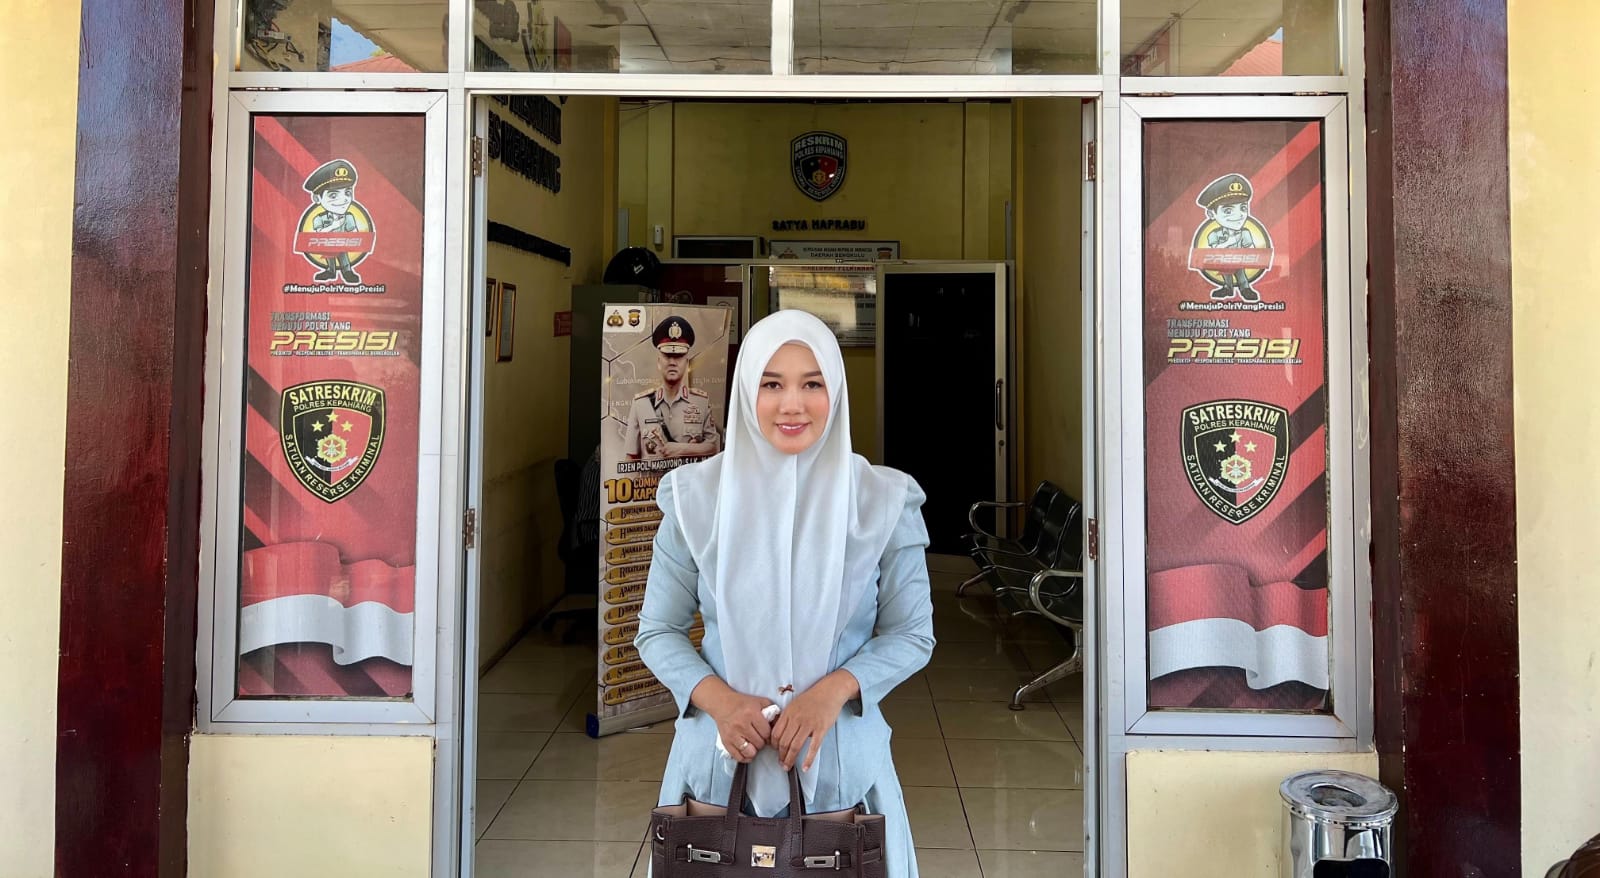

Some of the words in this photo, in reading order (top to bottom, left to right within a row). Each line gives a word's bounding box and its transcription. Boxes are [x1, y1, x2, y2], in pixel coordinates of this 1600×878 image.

[794, 135, 844, 151] RESKRIM
[772, 220, 808, 231] SATYA
[812, 219, 866, 231] HAPRABU
[308, 238, 362, 247] PRESISI
[1203, 254, 1260, 263] PRESISI
[283, 284, 386, 294] #MenujuPolriYangPresisi
[1179, 301, 1285, 312] #MenujuPolriYangPresisi
[305, 321, 328, 331] POLRI
[329, 321, 351, 331] YANG
[1167, 319, 1229, 328] TRANSFORMASI
[1168, 328, 1201, 338] MENUJU
[1203, 328, 1227, 338] POLRI
[1229, 328, 1251, 338] YANG
[269, 331, 399, 351] PRESISI
[1167, 338, 1301, 358] PRESISI
[289, 385, 377, 406] SATRESKRIM
[294, 400, 325, 412] POLRES
[327, 400, 372, 413] KEPAHIANG
[1189, 404, 1281, 426] SATRESKRIM
[1194, 420, 1227, 432] POLRES
[1229, 420, 1276, 433] KEPAHIANG
[285, 434, 307, 474] SATUAN
[304, 473, 351, 496] RESERSE
[349, 435, 380, 482] KRIMINAL
[618, 463, 636, 473] IRJEN
[633, 476, 660, 489] COMM
[1187, 454, 1211, 496] SATUAN
[1209, 494, 1257, 518] RESERSE
[1255, 455, 1285, 503] KRIMINAL
[604, 478, 633, 504] 10
